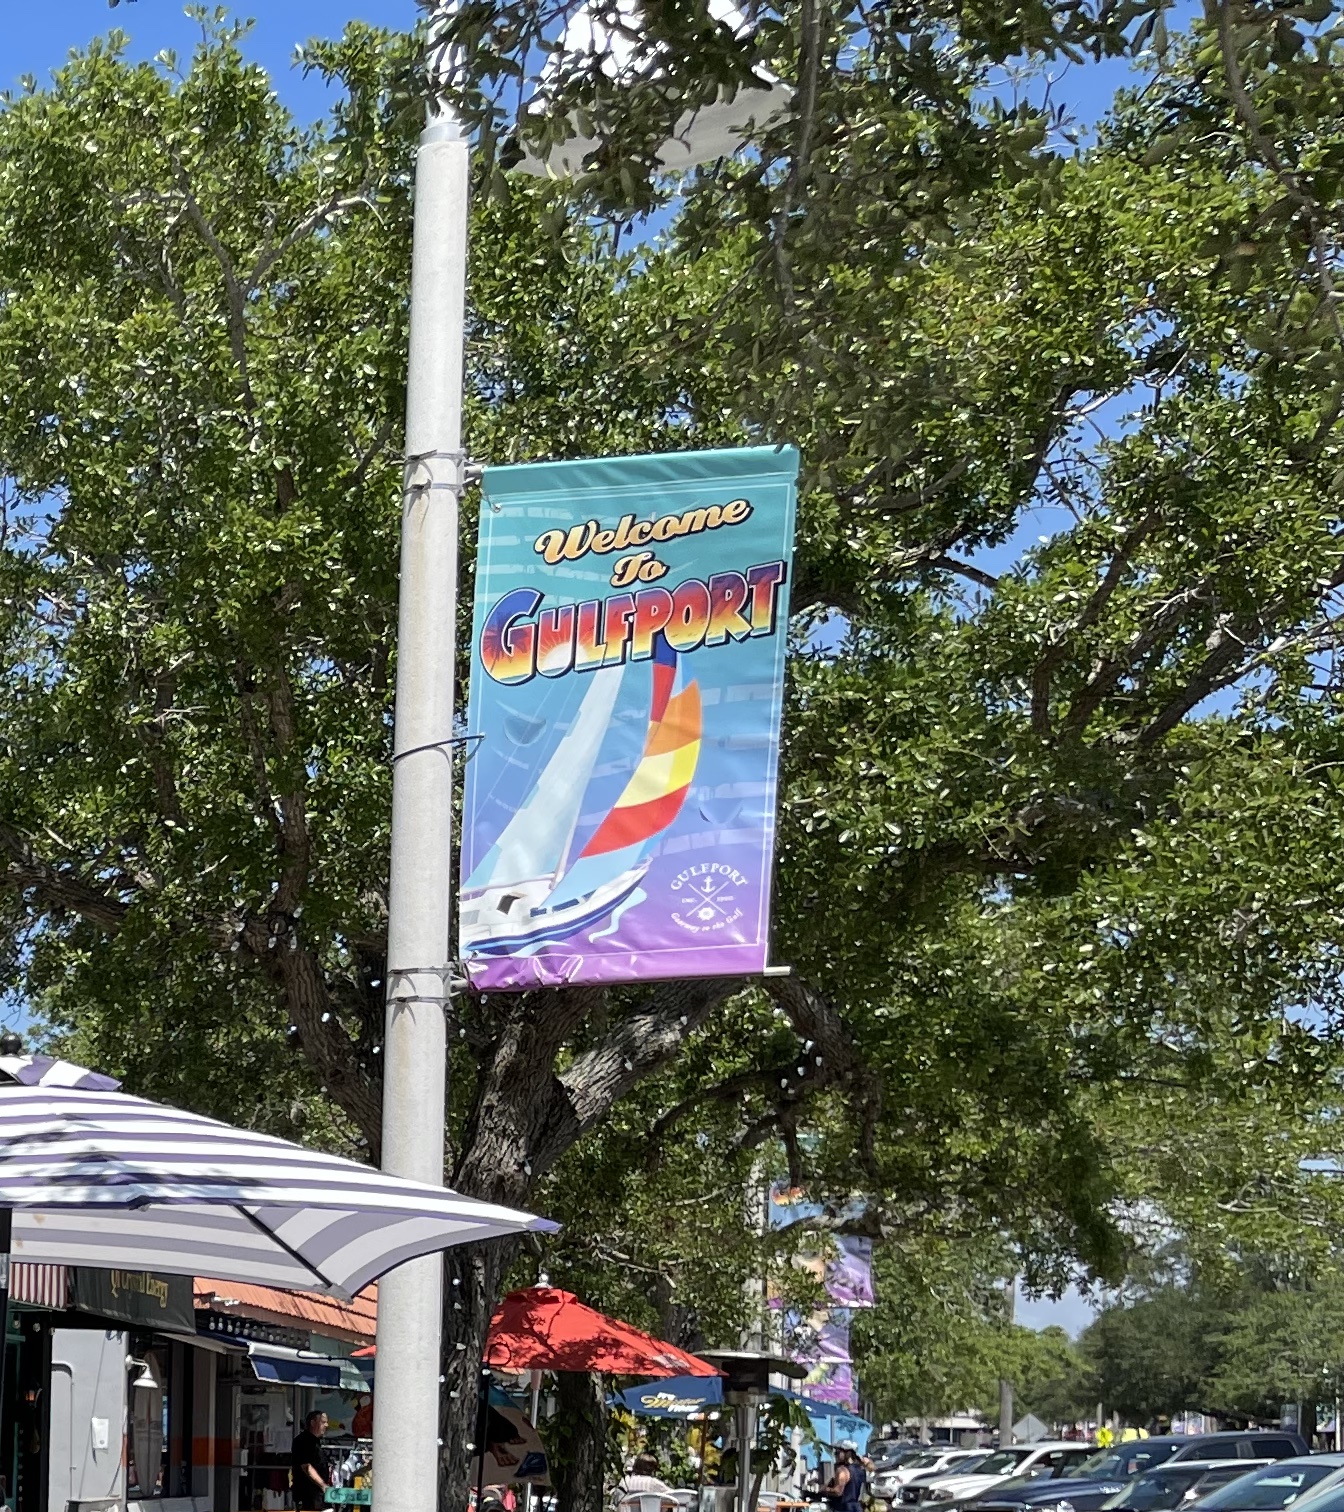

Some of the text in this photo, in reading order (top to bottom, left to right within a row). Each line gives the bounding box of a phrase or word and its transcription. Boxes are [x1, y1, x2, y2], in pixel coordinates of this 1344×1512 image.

[534, 498, 753, 565] Welcome
[610, 550, 669, 588] To
[479, 560, 787, 686] GULFPORT
[670, 862, 748, 890] GULFPORT
